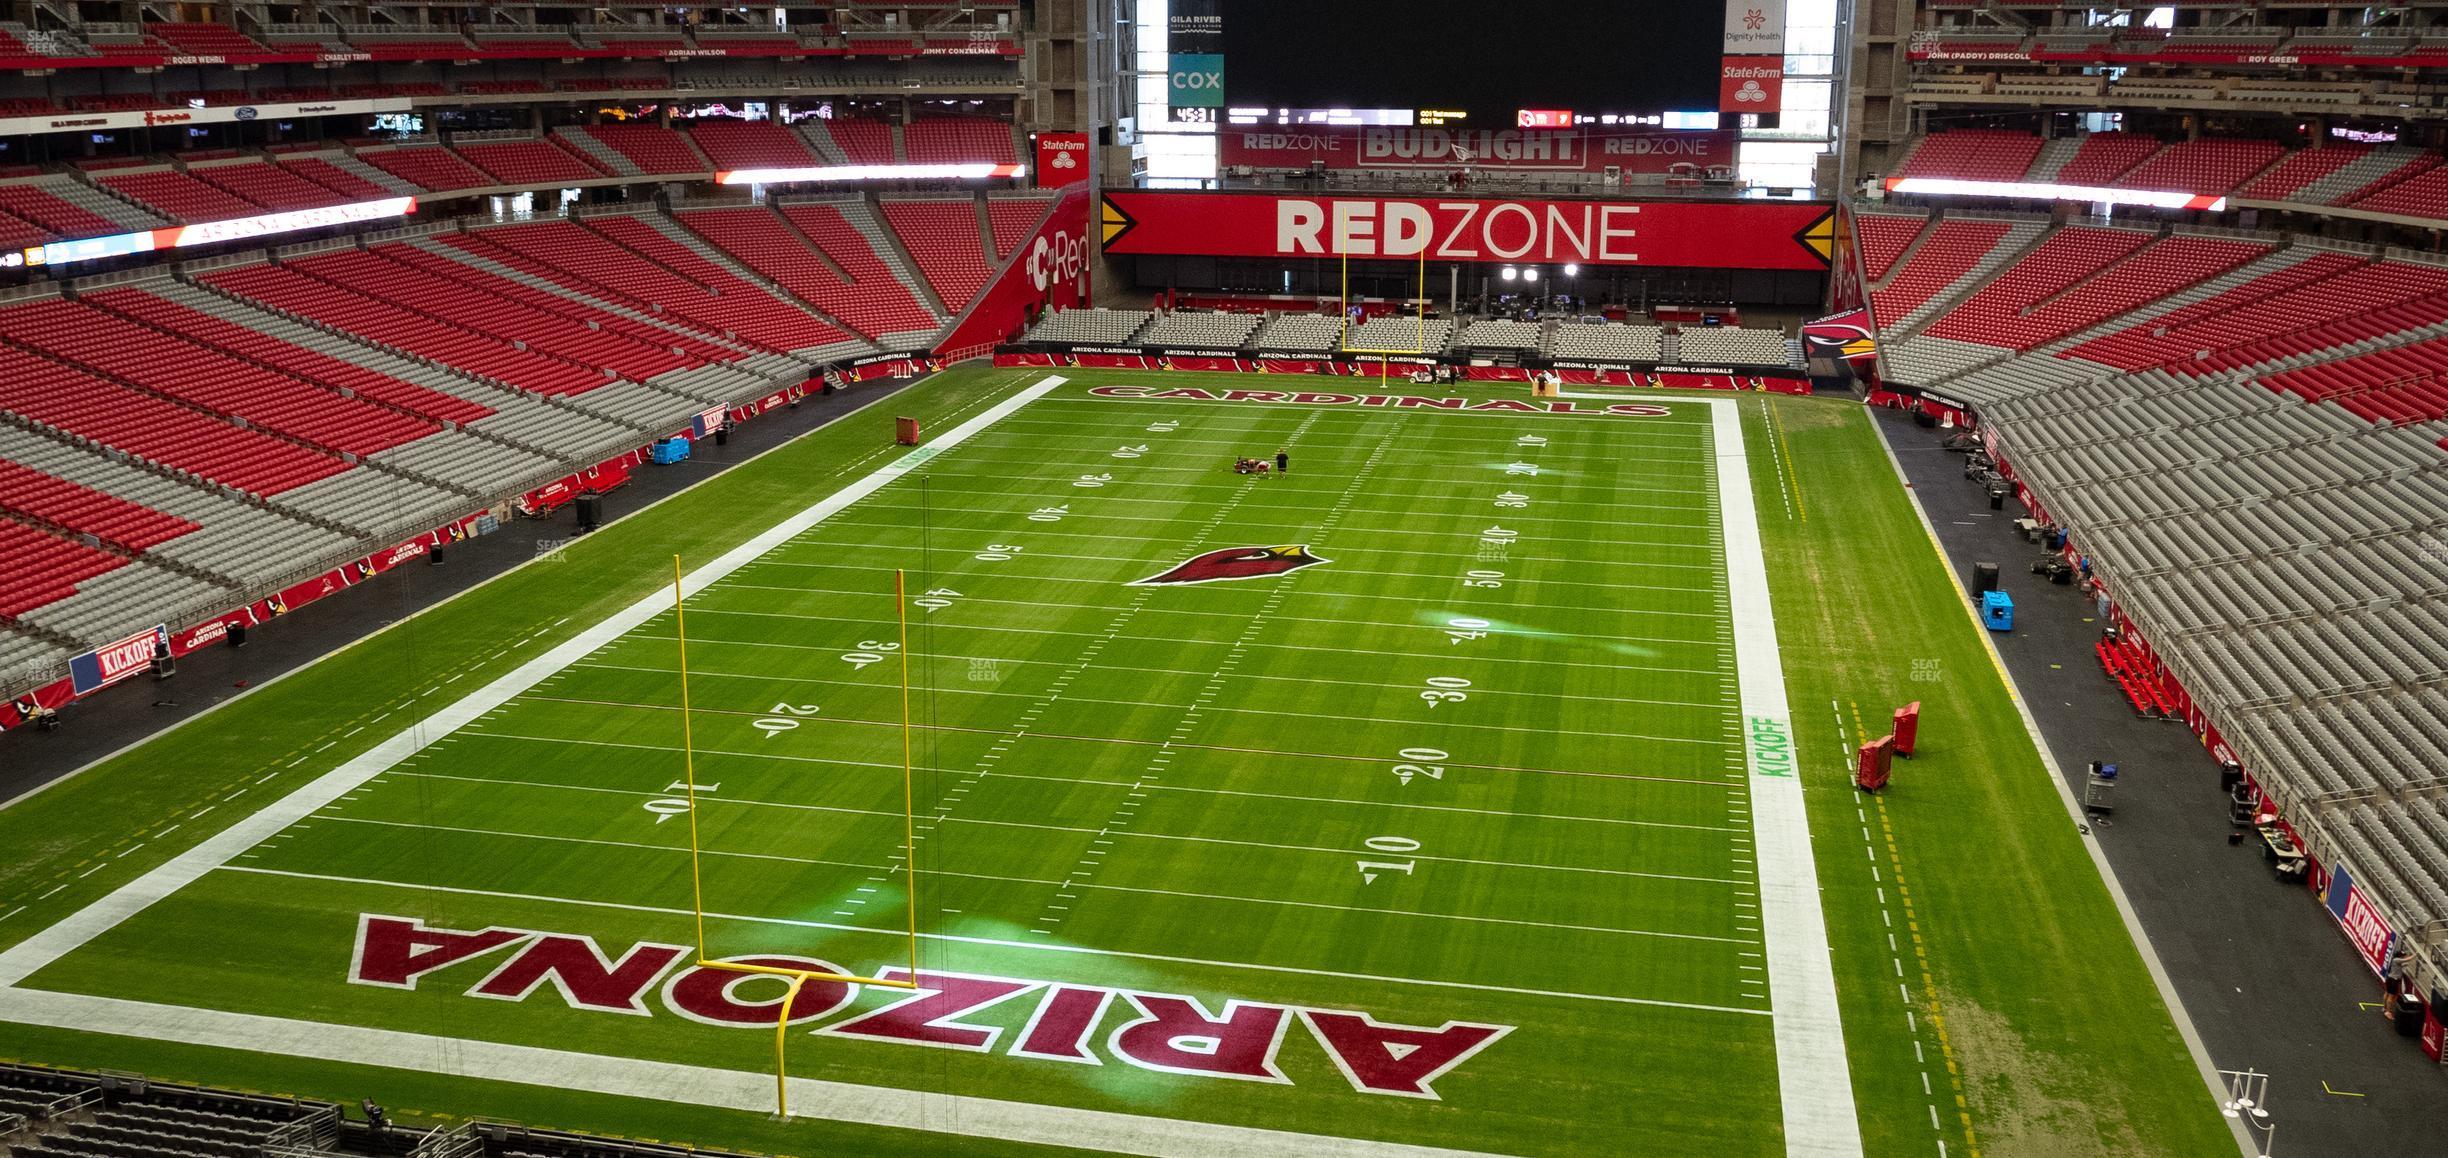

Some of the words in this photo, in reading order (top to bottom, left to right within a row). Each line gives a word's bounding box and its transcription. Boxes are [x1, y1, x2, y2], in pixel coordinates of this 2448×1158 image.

[1171, 15, 1192, 23] GILA
[1193, 15, 1222, 23] RIVER
[1726, 32, 1753, 42] Dignity
[1755, 32, 1781, 40] Health
[172, 56, 198, 64] ROGER
[198, 55, 226, 64] WEHRLI
[324, 53, 351, 61] CHARLEY
[352, 53, 372, 61] TRIPPI
[1951, 52, 1987, 60] (PADDY)
[1989, 52, 2031, 60] DRISCOLL
[2248, 55, 2268, 63] ROY
[2268, 55, 2299, 64] GREEN
[1172, 71, 1220, 89] COX
[1176, 107, 1216, 123] 45:31
[1243, 133, 1341, 151] REDZONE
[1366, 128, 1450, 158] BUD
[1458, 129, 1578, 160] LIGHT
[1604, 137, 1708, 156] REDZONE
[1276, 199, 1641, 261] REDZONE
[853, 356, 878, 366] ARIZONA
[877, 352, 912, 362] CARDINALS
[1103, 347, 1143, 355] CARDINALS
[1164, 349, 1196, 357] ARIZONA
[1197, 350, 1237, 358] CARDINALS
[1258, 352, 1291, 360] ARIZONA
[1292, 353, 1333, 361] CARDINALS
[1552, 361, 1587, 369] ARIZONA
[1655, 365, 1689, 373] ARIZONA
[1690, 367, 1734, 375] CARDINALS
[1087, 385, 1673, 418] CARDINALS
[1146, 420, 1180, 433] 10
[1517, 436, 1549, 448] 10
[1111, 444, 1149, 459] 20
[1072, 473, 1113, 488] 30
[1493, 494, 1530, 509] 30
[1027, 504, 1069, 522] 40
[974, 543, 1024, 562] 50
[1462, 570, 1505, 589] 50
[913, 587, 964, 608] 40
[186, 625, 228, 649] CARDINAL
[194, 620, 224, 637] ARIZONA
[1444, 617, 1491, 640] 40
[100, 635, 157, 677] KICKOFF
[840, 640, 900, 665] 30
[1419, 676, 1472, 704] 30
[751, 702, 820, 731] 20
[1752, 716, 1793, 778] KICKOFF
[1391, 747, 1449, 781] 20
[642, 779, 721, 814] 10
[1356, 836, 1422, 876] 10
[2344, 891, 2386, 959] KICKOFF
[346, 912, 1518, 1100] ARIZONA
